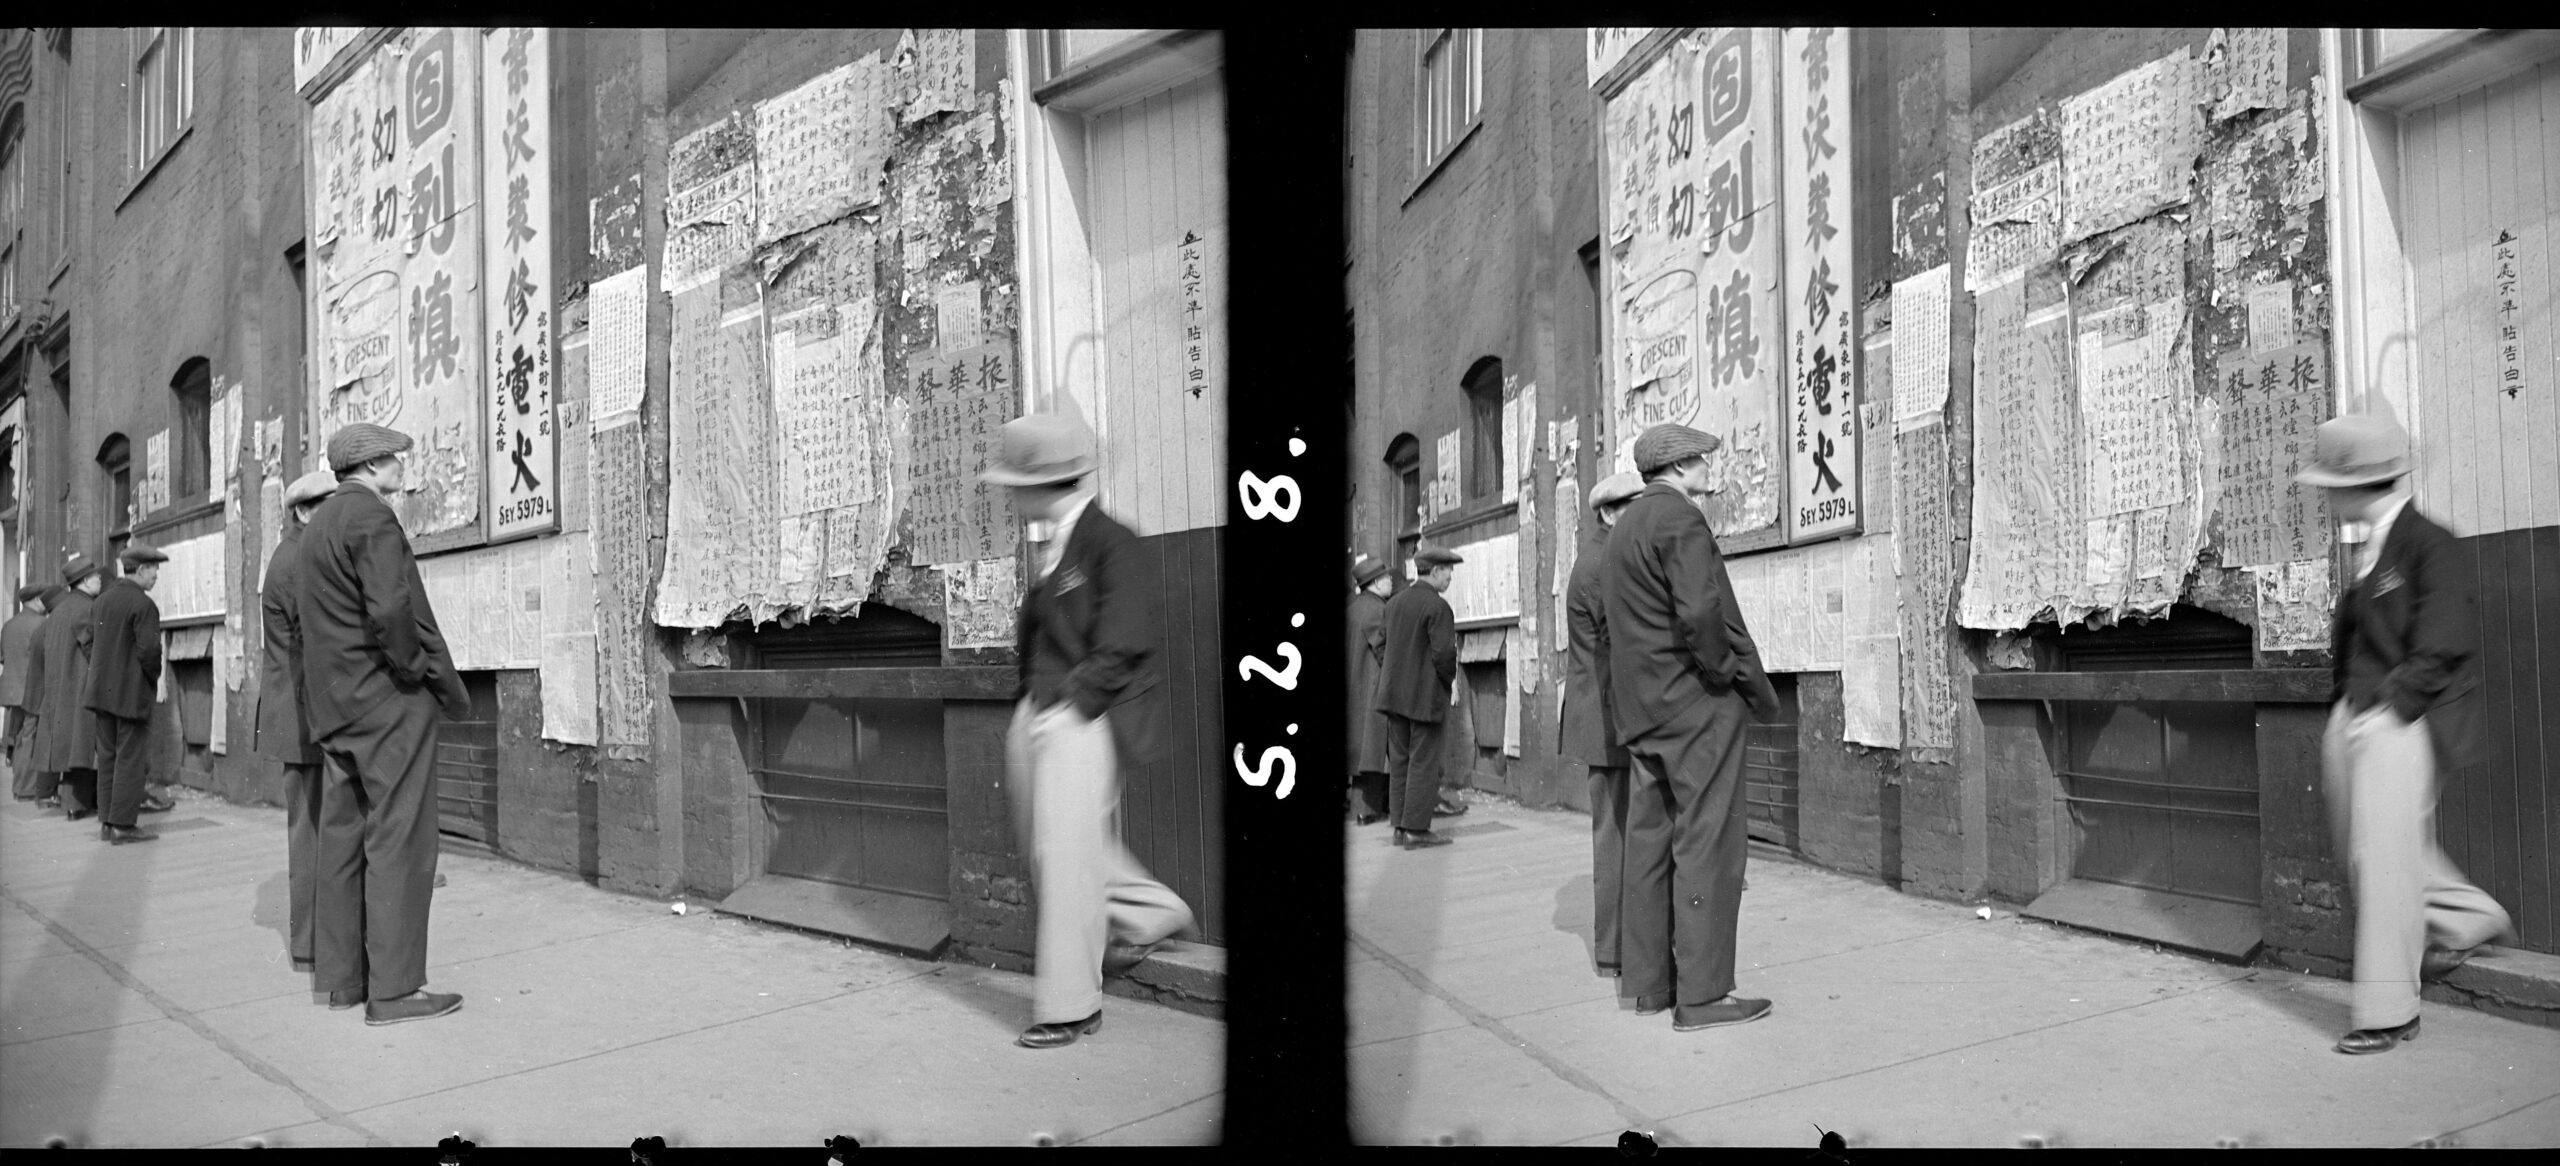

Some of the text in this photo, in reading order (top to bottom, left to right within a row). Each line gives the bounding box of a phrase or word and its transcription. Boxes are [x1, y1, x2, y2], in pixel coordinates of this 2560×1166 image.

[344, 334, 390, 374] CRESCENT
[1640, 334, 1688, 375] CRESCENT
[347, 388, 391, 421] FINE CUT
[1644, 388, 1689, 422] FINE CUT
[517, 496, 544, 520] 5979
[546, 502, 553, 514] L
[1818, 496, 1846, 520] 5979
[1848, 502, 1855, 514] L
